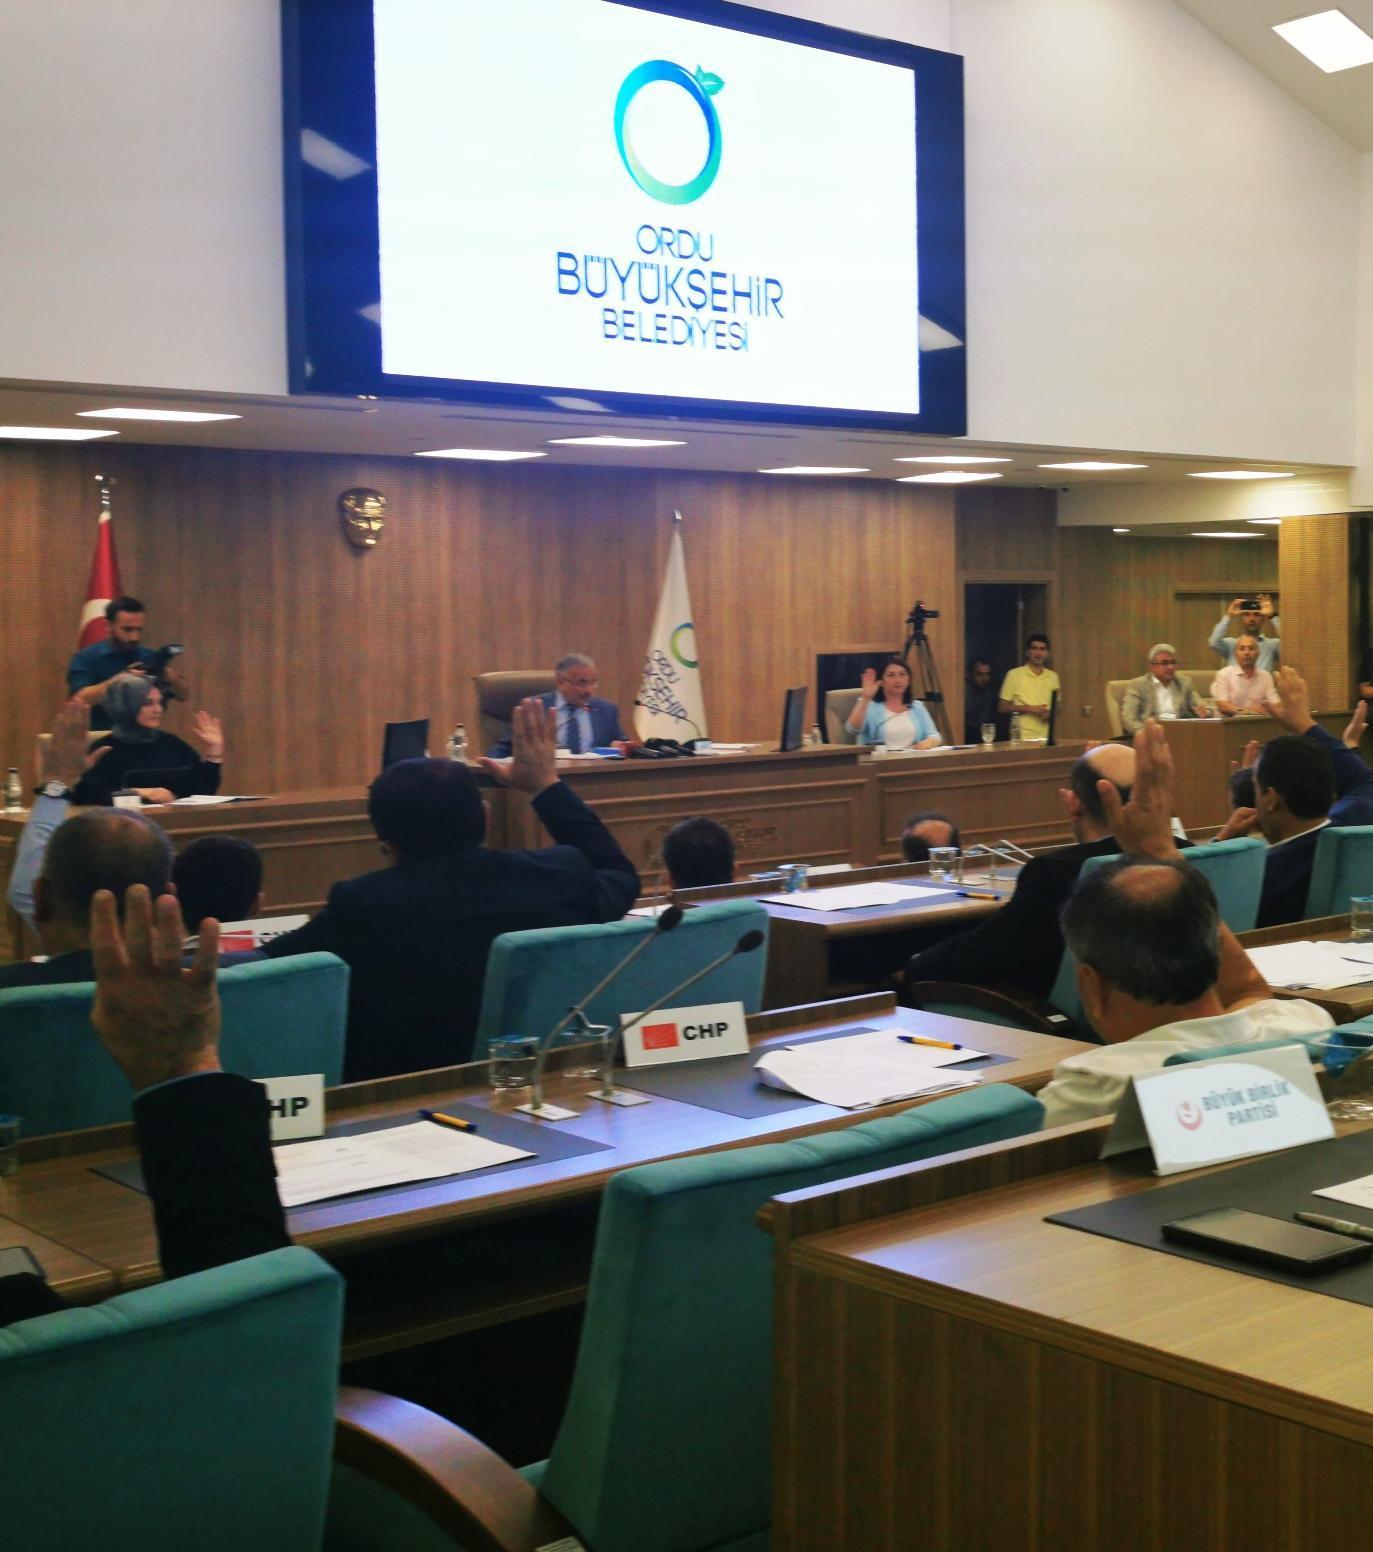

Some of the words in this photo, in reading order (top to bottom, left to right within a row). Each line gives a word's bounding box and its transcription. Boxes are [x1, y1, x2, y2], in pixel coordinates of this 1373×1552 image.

[636, 224, 713, 262] ORDU
[557, 251, 784, 319] BÜYÜKŞEHİR
[603, 307, 748, 352] BELEDİYESİ
[651, 649, 681, 684] ORDU
[683, 1022, 729, 1041] CHP
[267, 1096, 309, 1118] HP
[1202, 1087, 1246, 1112] BÜYÜK
